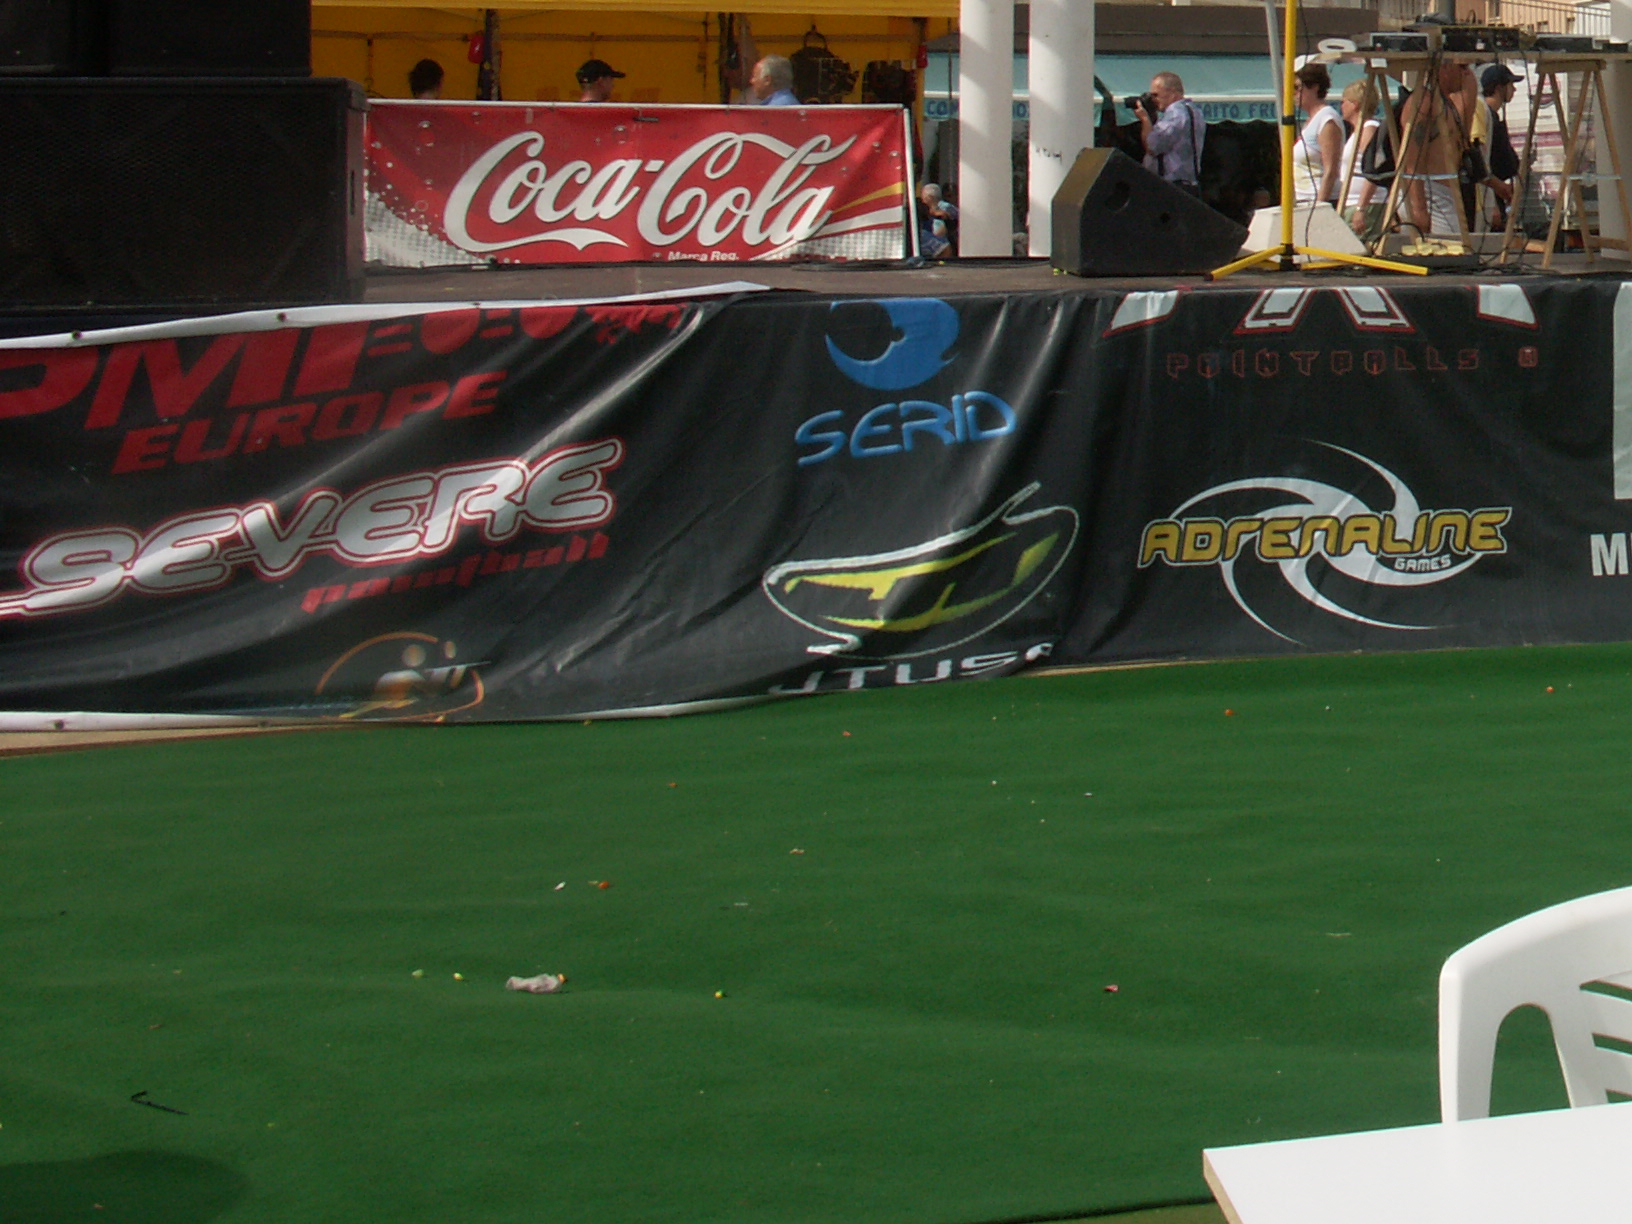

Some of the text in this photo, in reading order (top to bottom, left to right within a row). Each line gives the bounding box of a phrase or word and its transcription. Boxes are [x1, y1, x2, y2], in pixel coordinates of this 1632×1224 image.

[443, 130, 858, 253] Coca-Cola
[112, 370, 507, 475] EUROPE
[18, 437, 625, 616] SEVERE
[1138, 506, 1514, 568] ADRENALINE
[1394, 555, 1452, 582] GAMES
[300, 533, 610, 614] paintball
